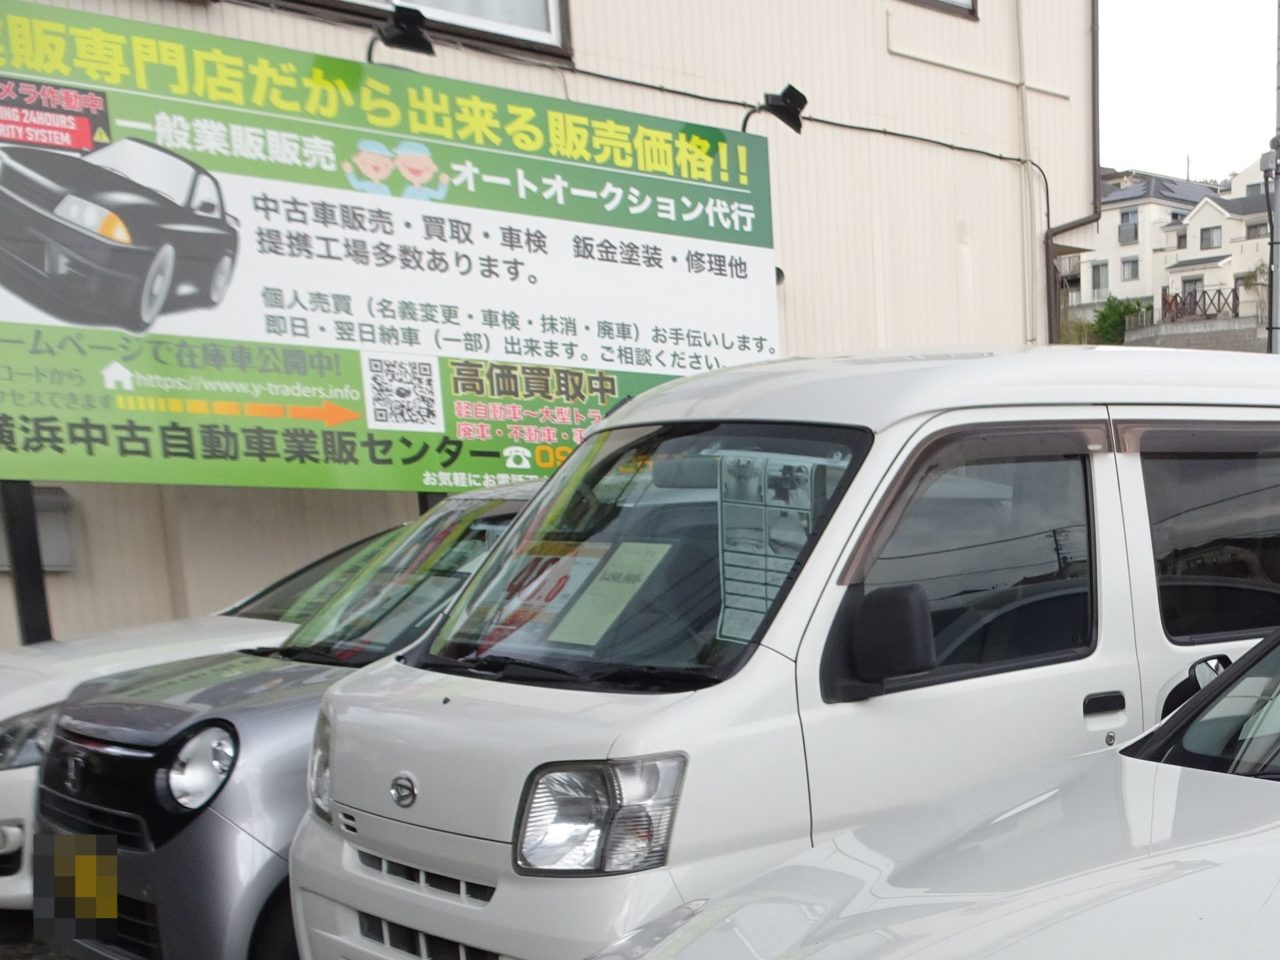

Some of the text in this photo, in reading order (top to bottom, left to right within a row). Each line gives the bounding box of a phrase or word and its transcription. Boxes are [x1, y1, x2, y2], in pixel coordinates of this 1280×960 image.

[0, 14, 750, 186] 販専門店だから出来る販売価格!!
[22, 109, 77, 131] 24HOURS
[25, 126, 71, 146] SYSTEM
[115, 111, 337, 172] 一般業販販売
[450, 160, 755, 233] オートオークション代行
[252, 192, 749, 281] 中古車販売・買取・車検 鈑金塗装・修理他
[255, 226, 538, 285] 提携工場多数あります。
[0, 390, 114, 410] セスできます
[135, 371, 361, 401] https://www.y-traders.info
[450, 359, 619, 407] 高価買取中
